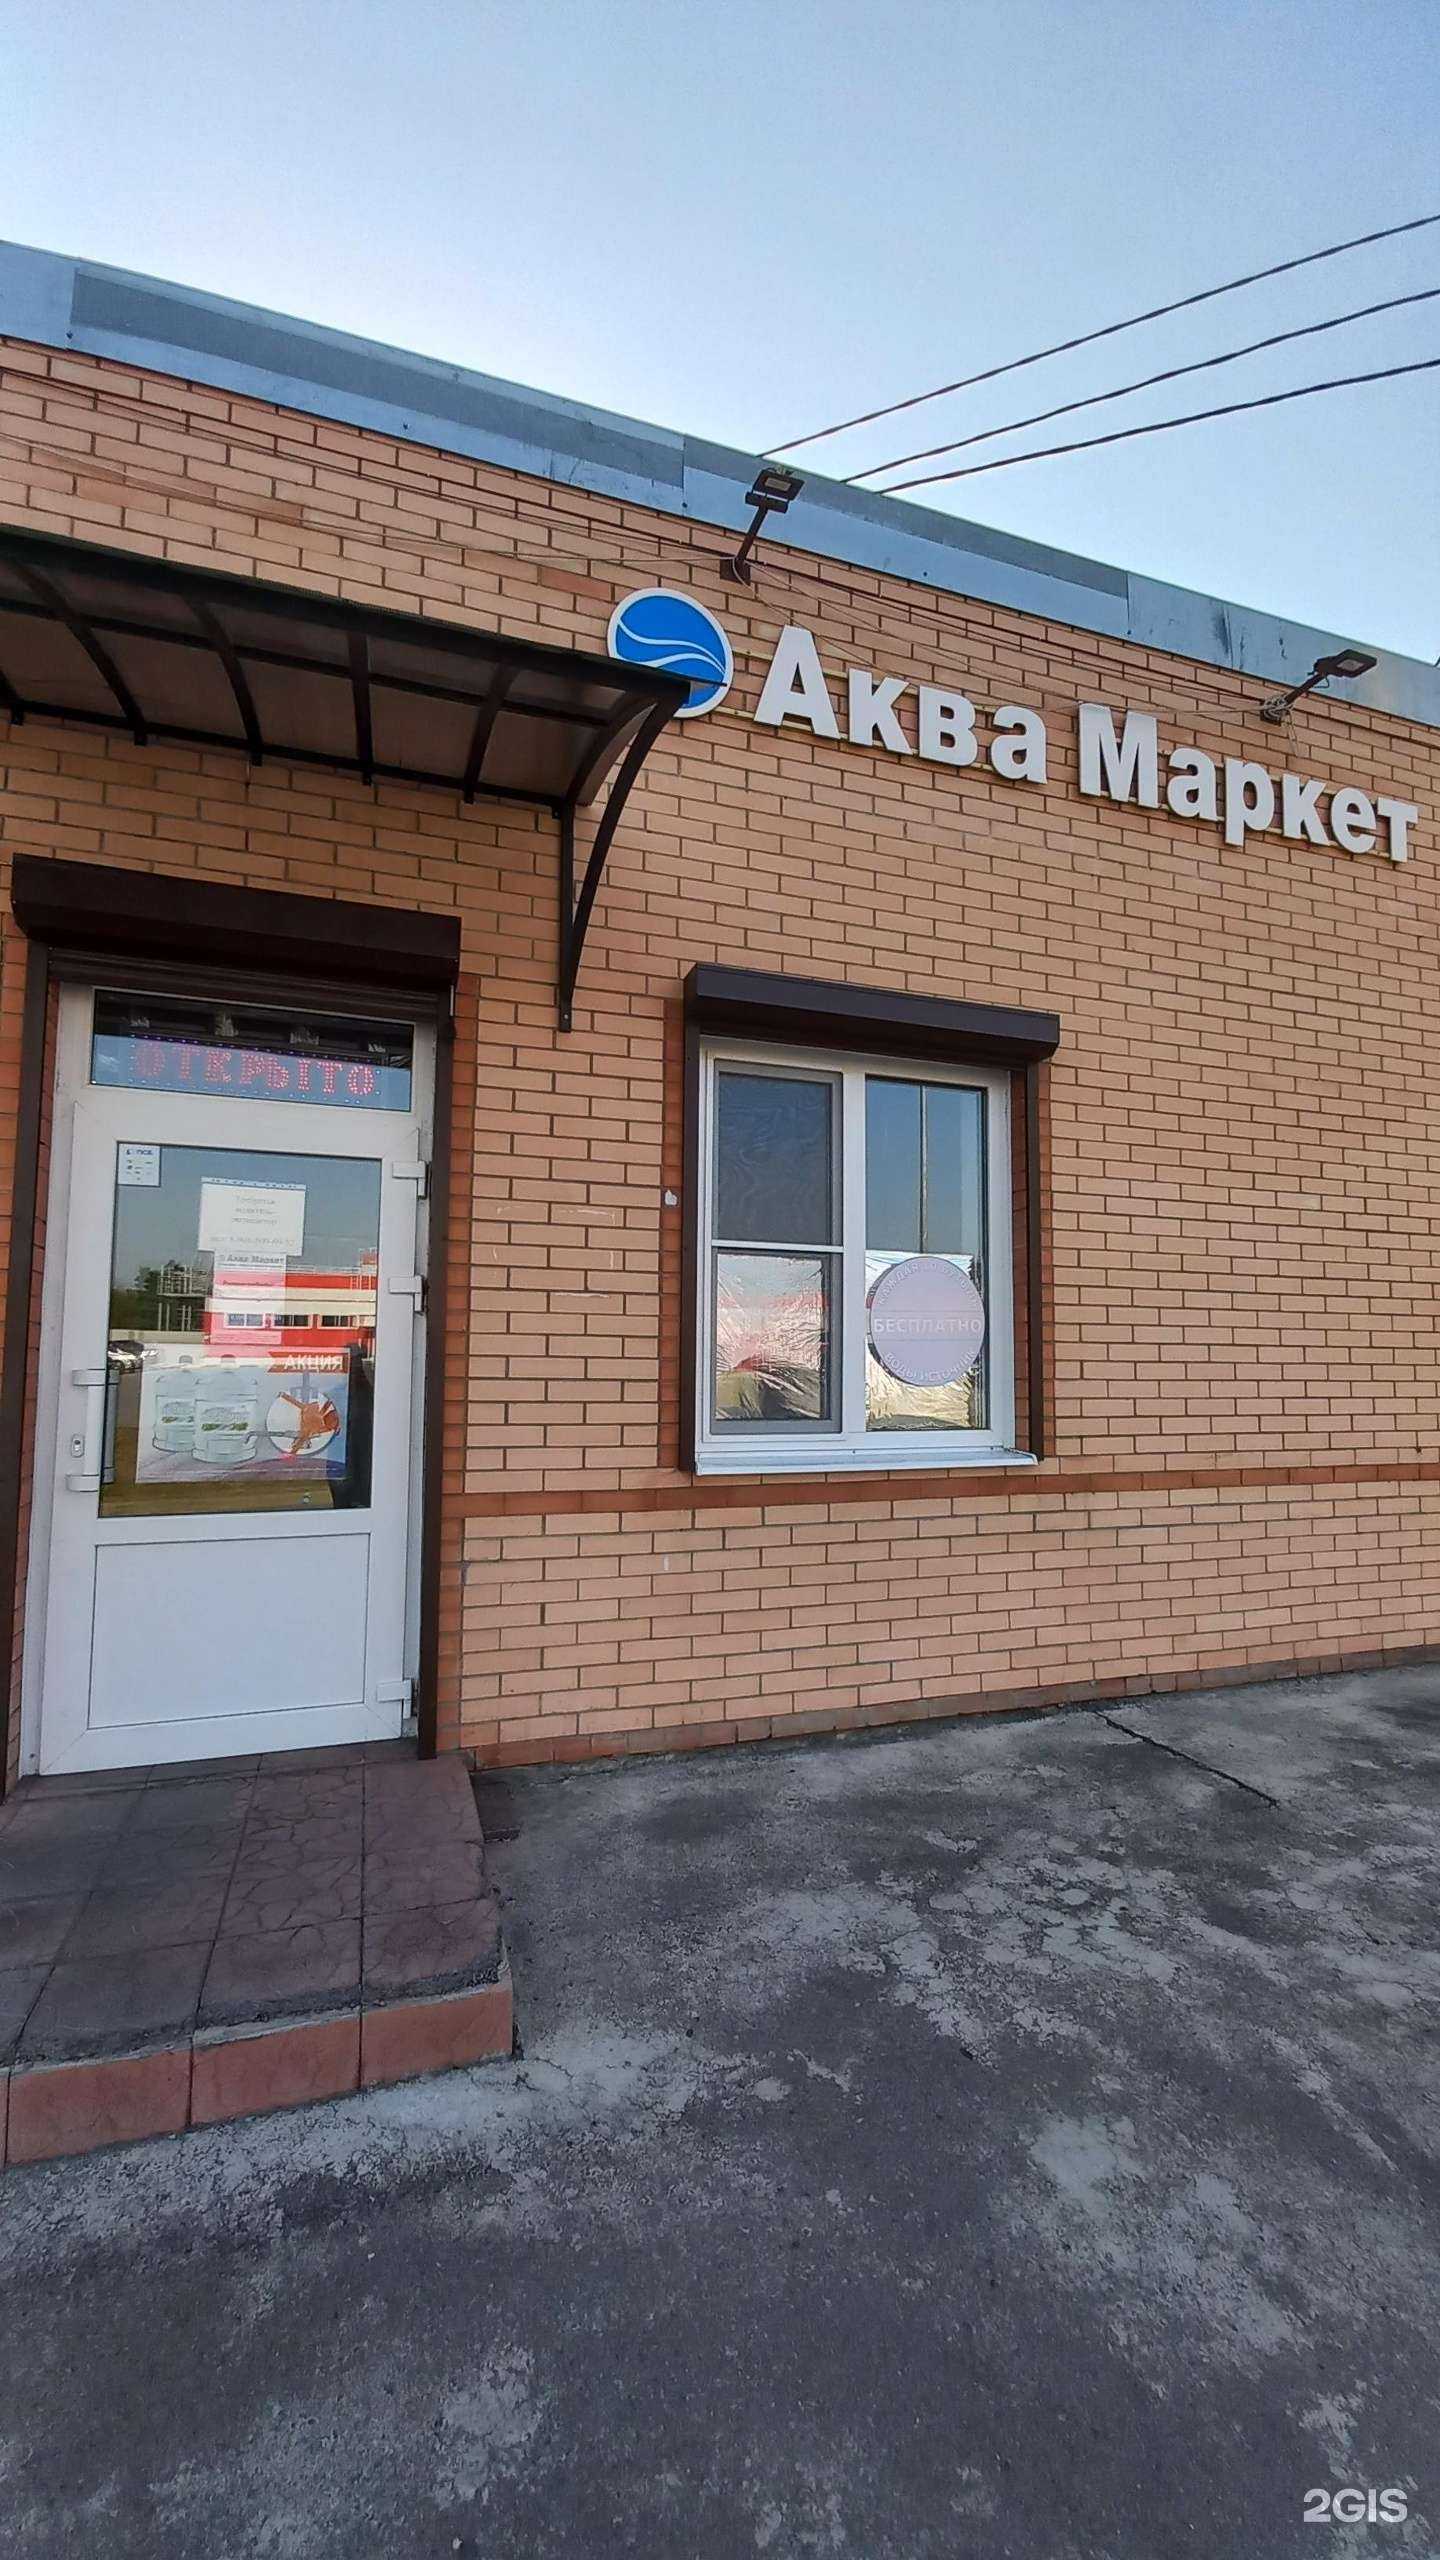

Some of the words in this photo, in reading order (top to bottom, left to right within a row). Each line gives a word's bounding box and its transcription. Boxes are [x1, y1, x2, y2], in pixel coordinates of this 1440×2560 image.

[754, 625, 1047, 784] Аква
[1078, 701, 1419, 863] Маркет
[134, 1041, 375, 1097] ОТКРЫТО
[873, 1318, 982, 1333] БЕСПЛАТНО
[284, 1355, 343, 1374] АКЦИЯ
